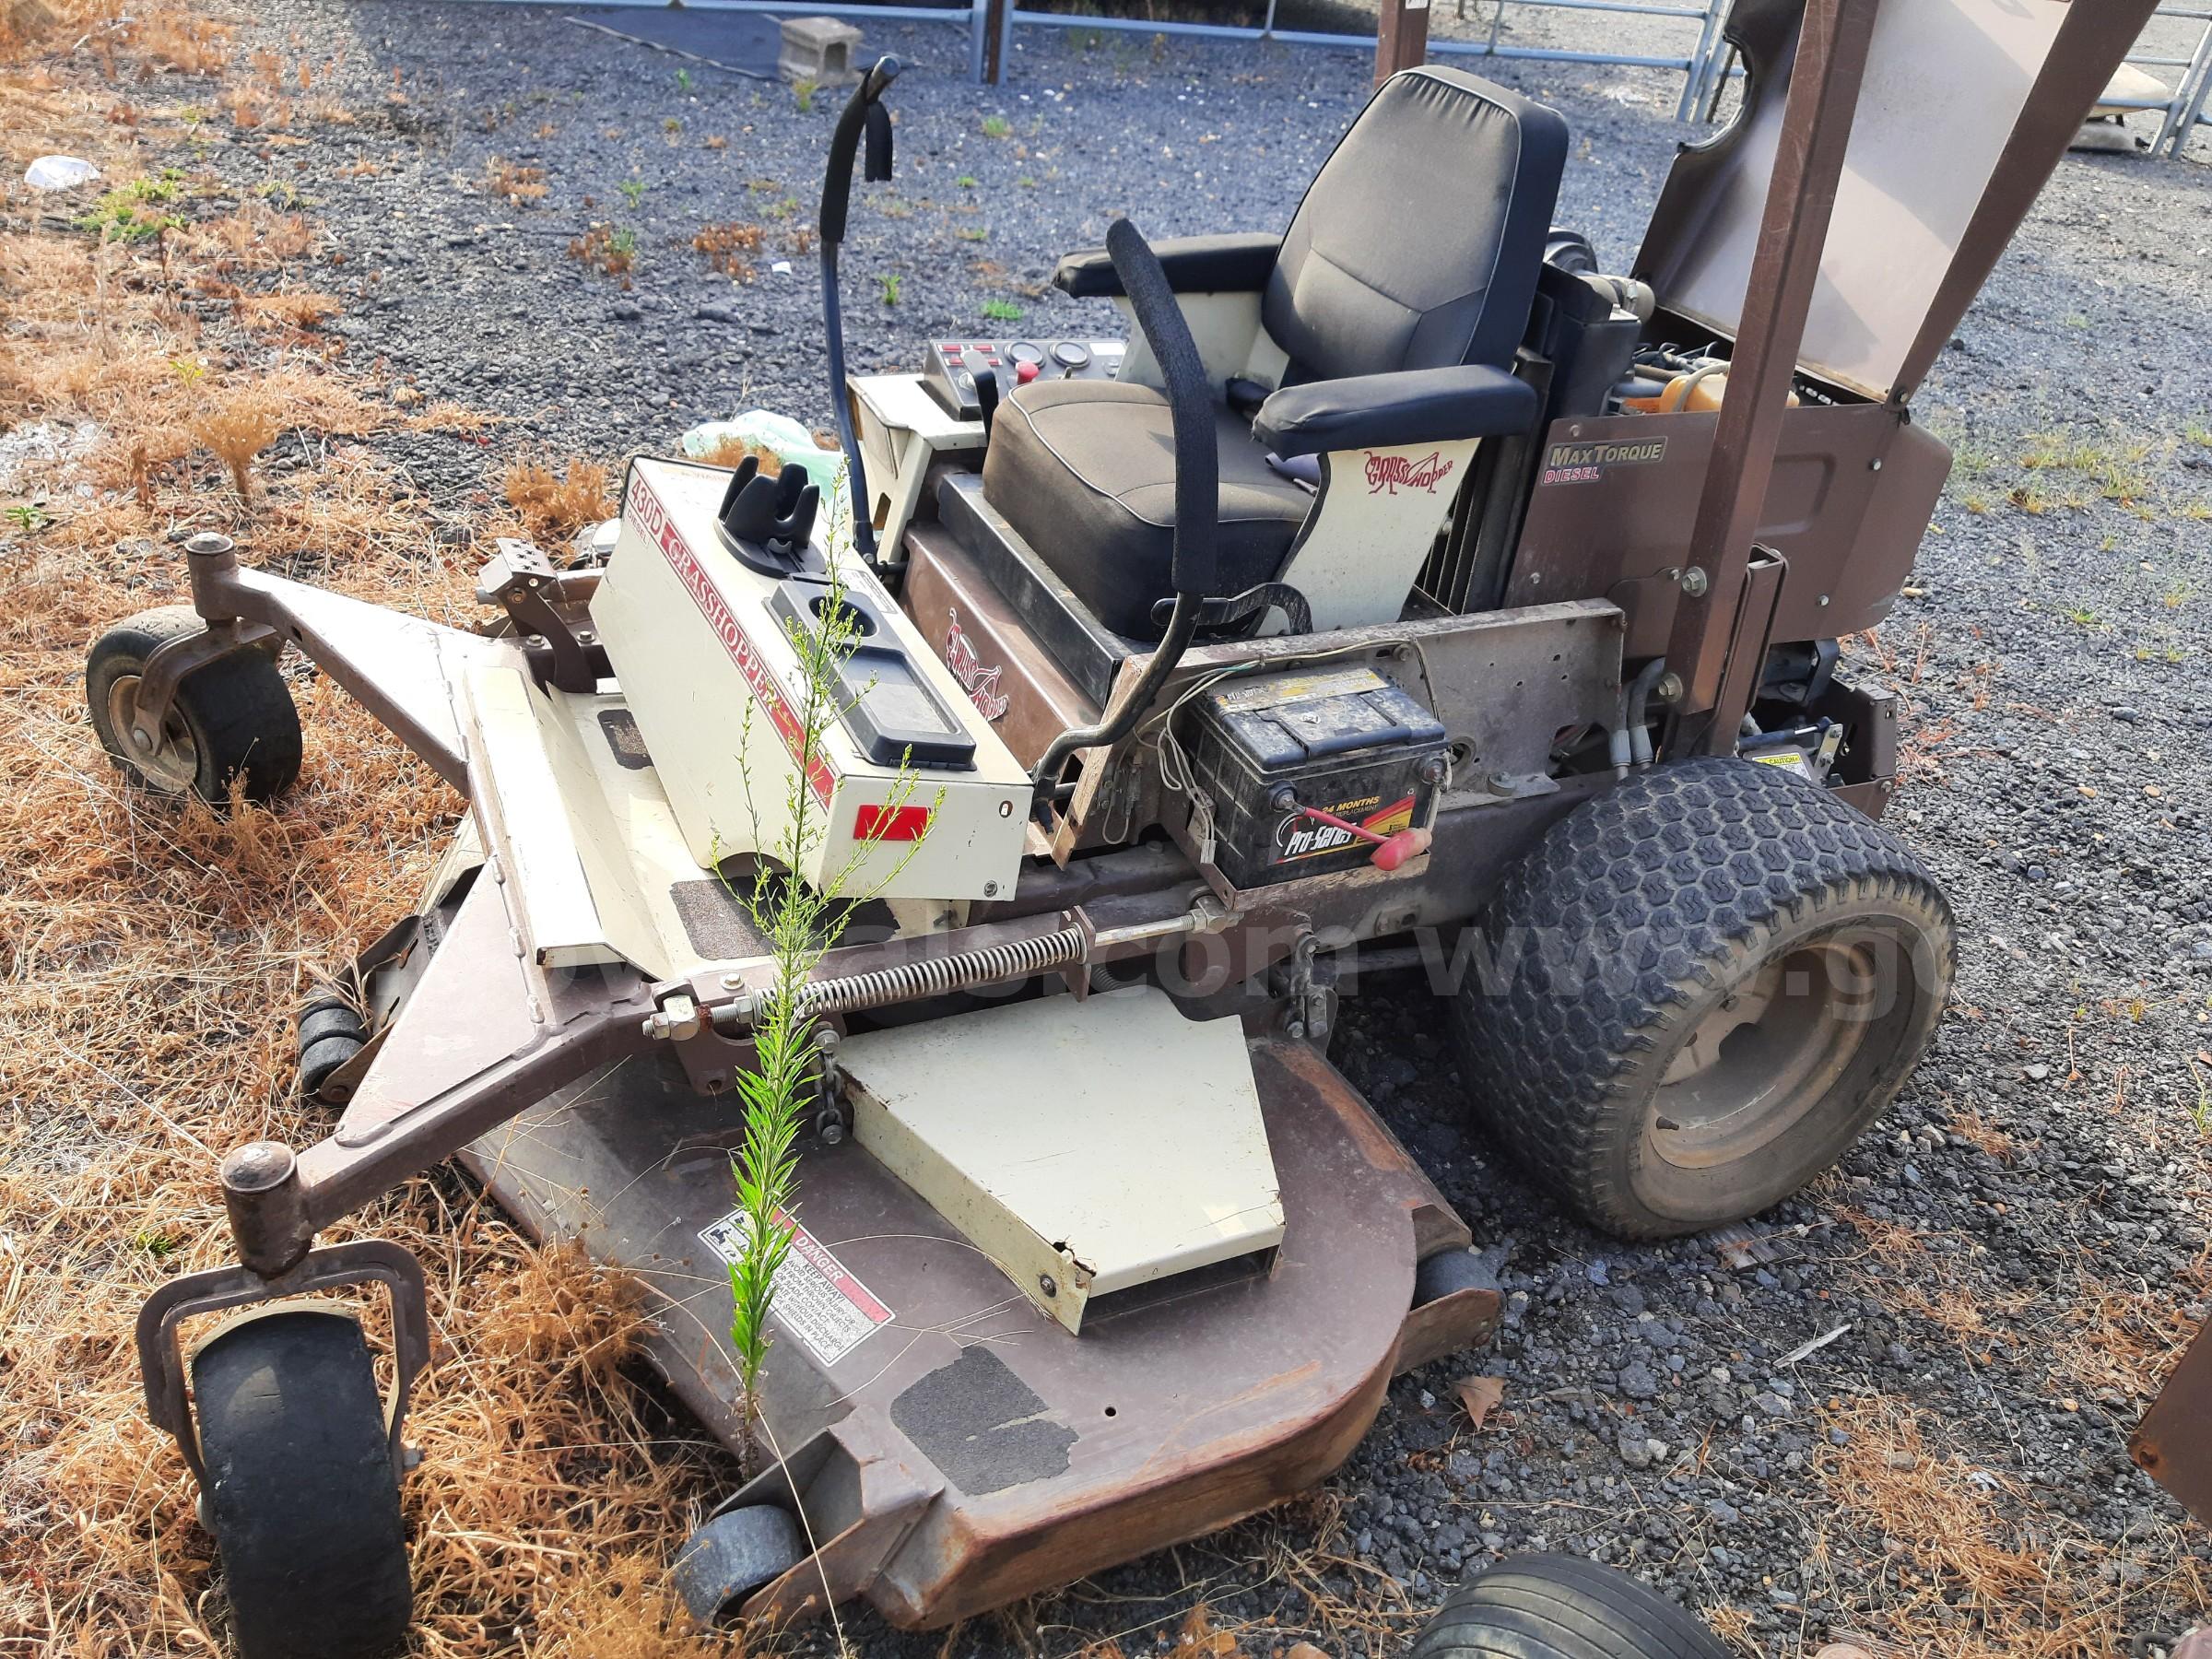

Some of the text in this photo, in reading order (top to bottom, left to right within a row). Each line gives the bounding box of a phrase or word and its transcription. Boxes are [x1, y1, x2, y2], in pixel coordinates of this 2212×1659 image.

[1543, 466, 1600, 484] DIESEL
[627, 508, 649, 546] DIESEL
[631, 479, 663, 535] 430D
[668, 537, 782, 712] GRASSHOPPER
[1336, 795, 1381, 812] MONTHS
[775, 1271, 786, 1281] OR
[794, 1236, 844, 1282] DANGER
[786, 1259, 806, 1277] AVOID
[803, 1276, 828, 1298] SERIOUS
[825, 1296, 846, 1316] INJURY
[786, 1270, 804, 1287] FROM
[802, 1286, 828, 1309] THROWN
[801, 1263, 845, 1303] KEEP AWAY!
[782, 1303, 806, 1325] SHIELDS
[810, 1330, 830, 1349] PLACE
[787, 1296, 812, 1319] WITHOUT
[810, 1318, 845, 1351] DISCHARGE
